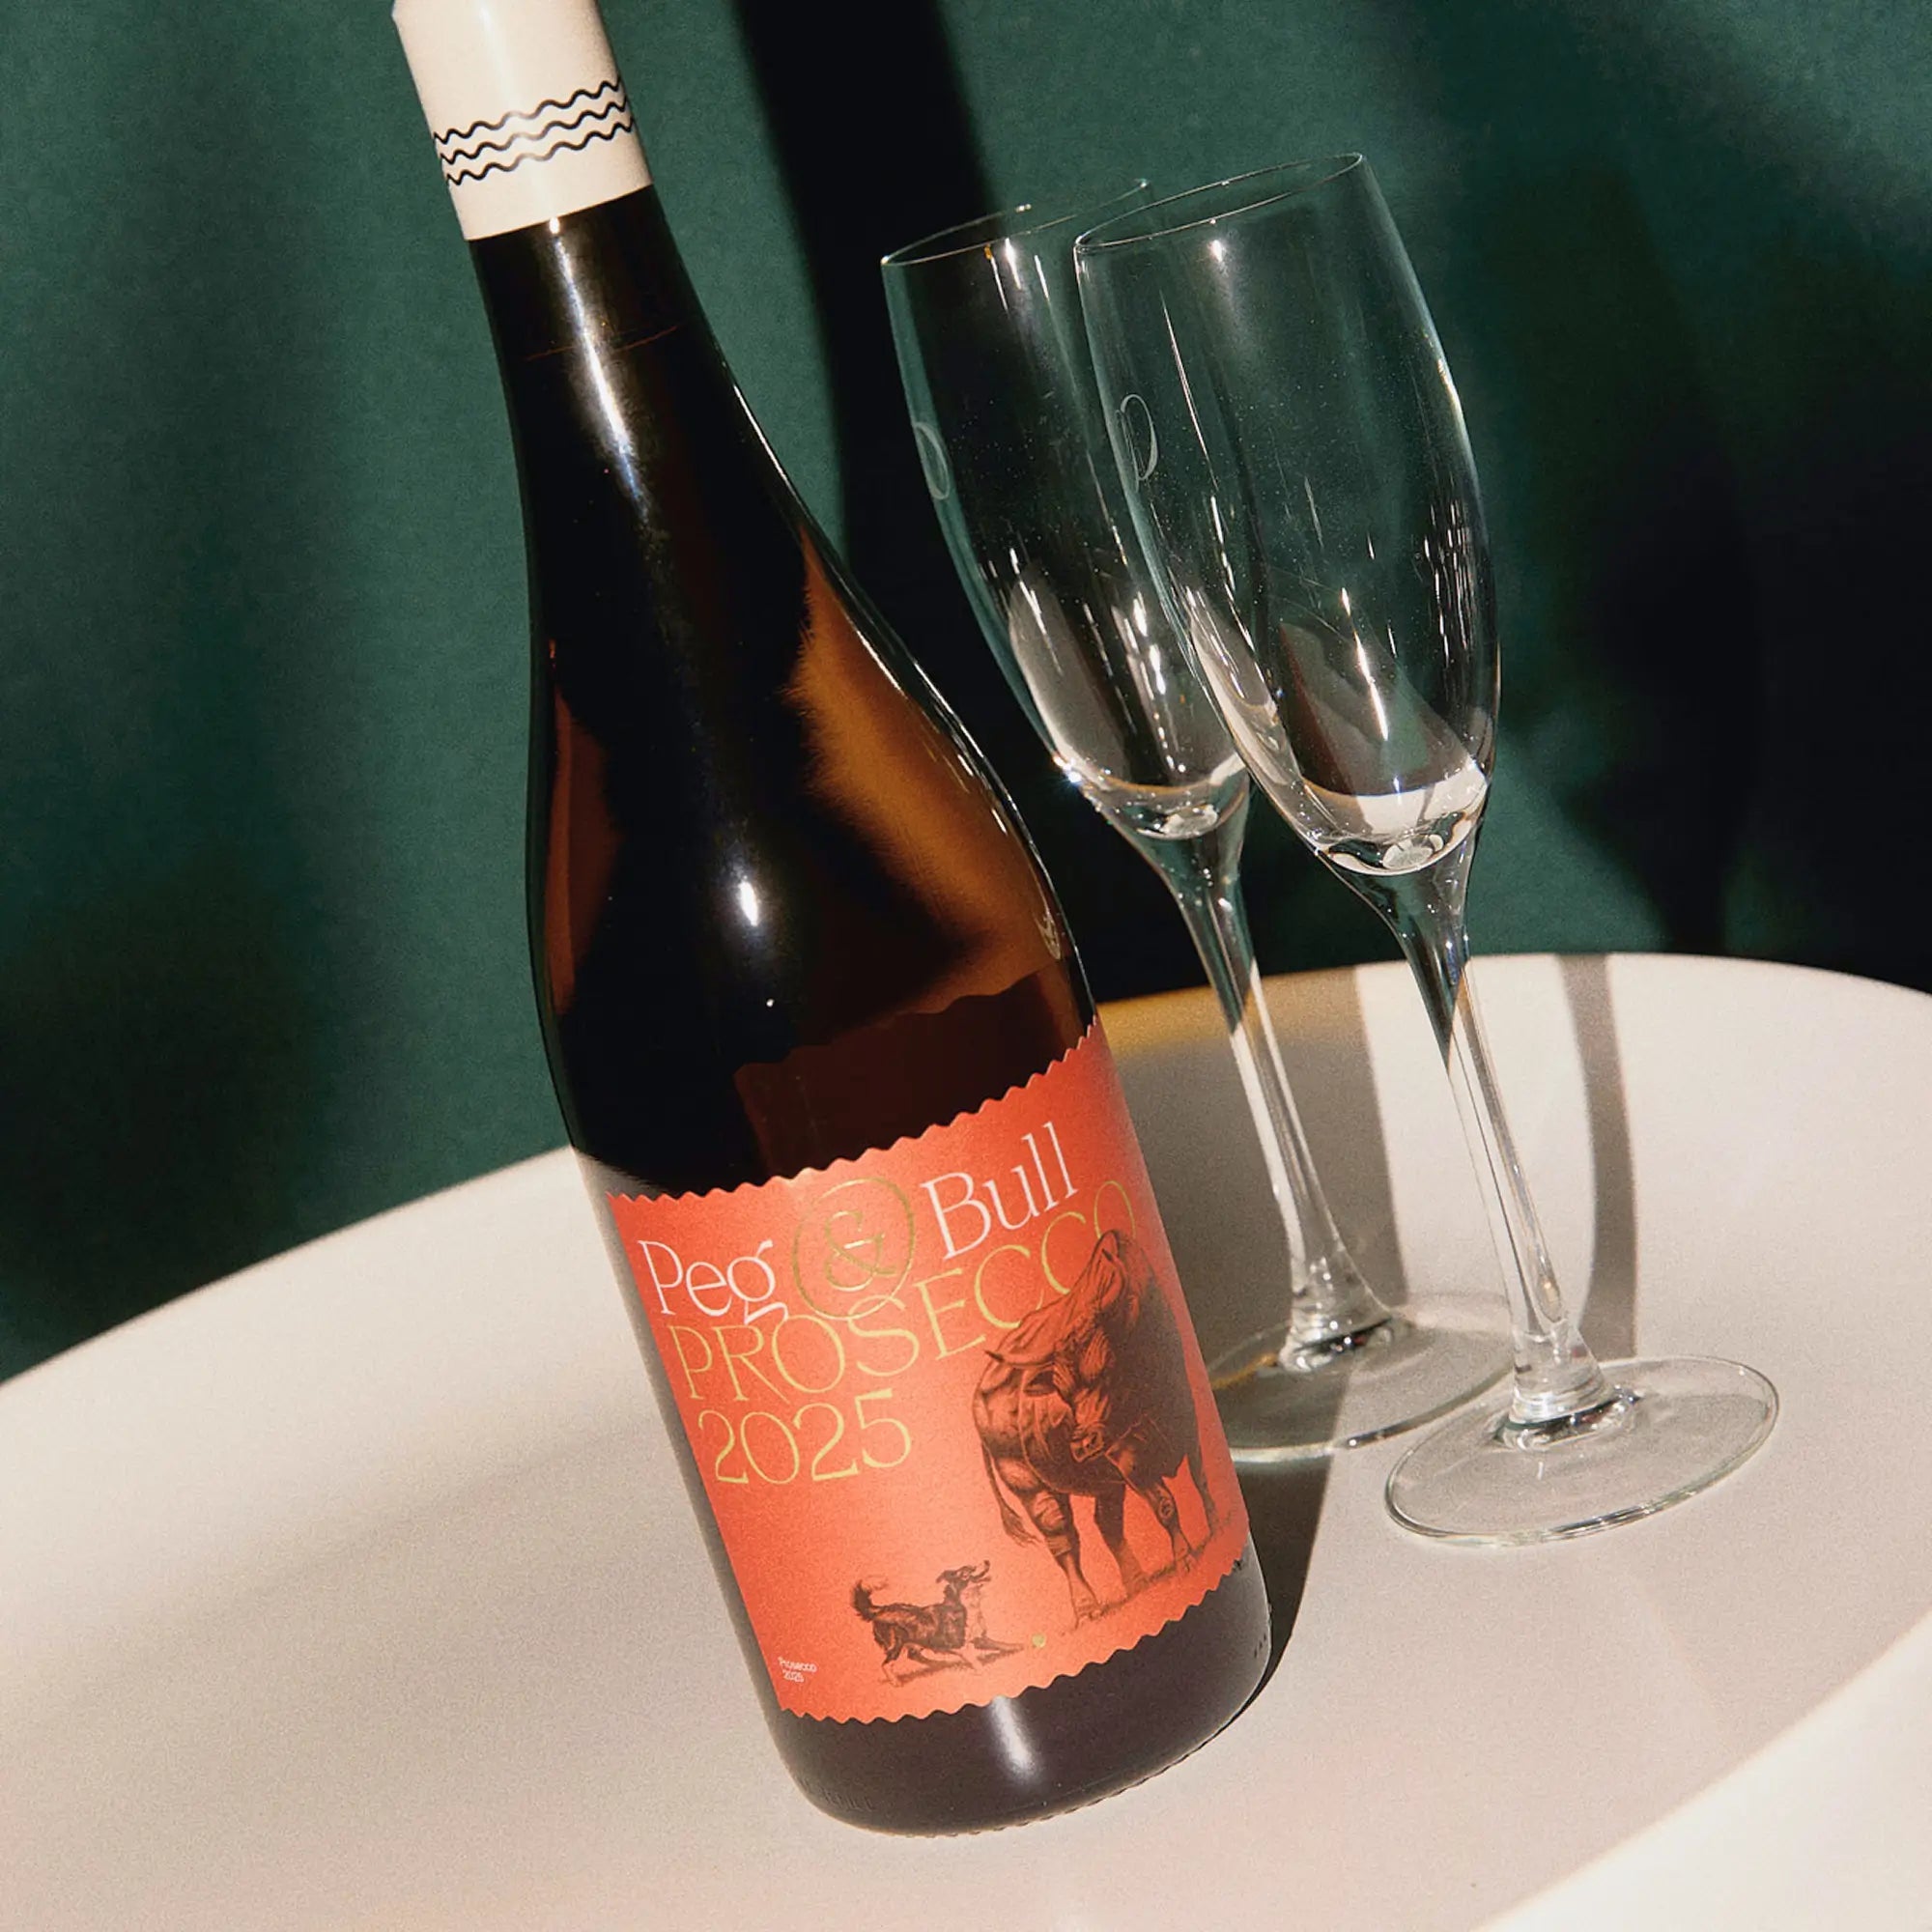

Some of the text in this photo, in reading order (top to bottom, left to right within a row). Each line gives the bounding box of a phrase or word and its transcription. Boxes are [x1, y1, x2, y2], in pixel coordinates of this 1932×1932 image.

[638, 1239, 788, 1325] Peg
[919, 1122, 1078, 1260] Bull
[698, 1388, 911, 1485] 2025
